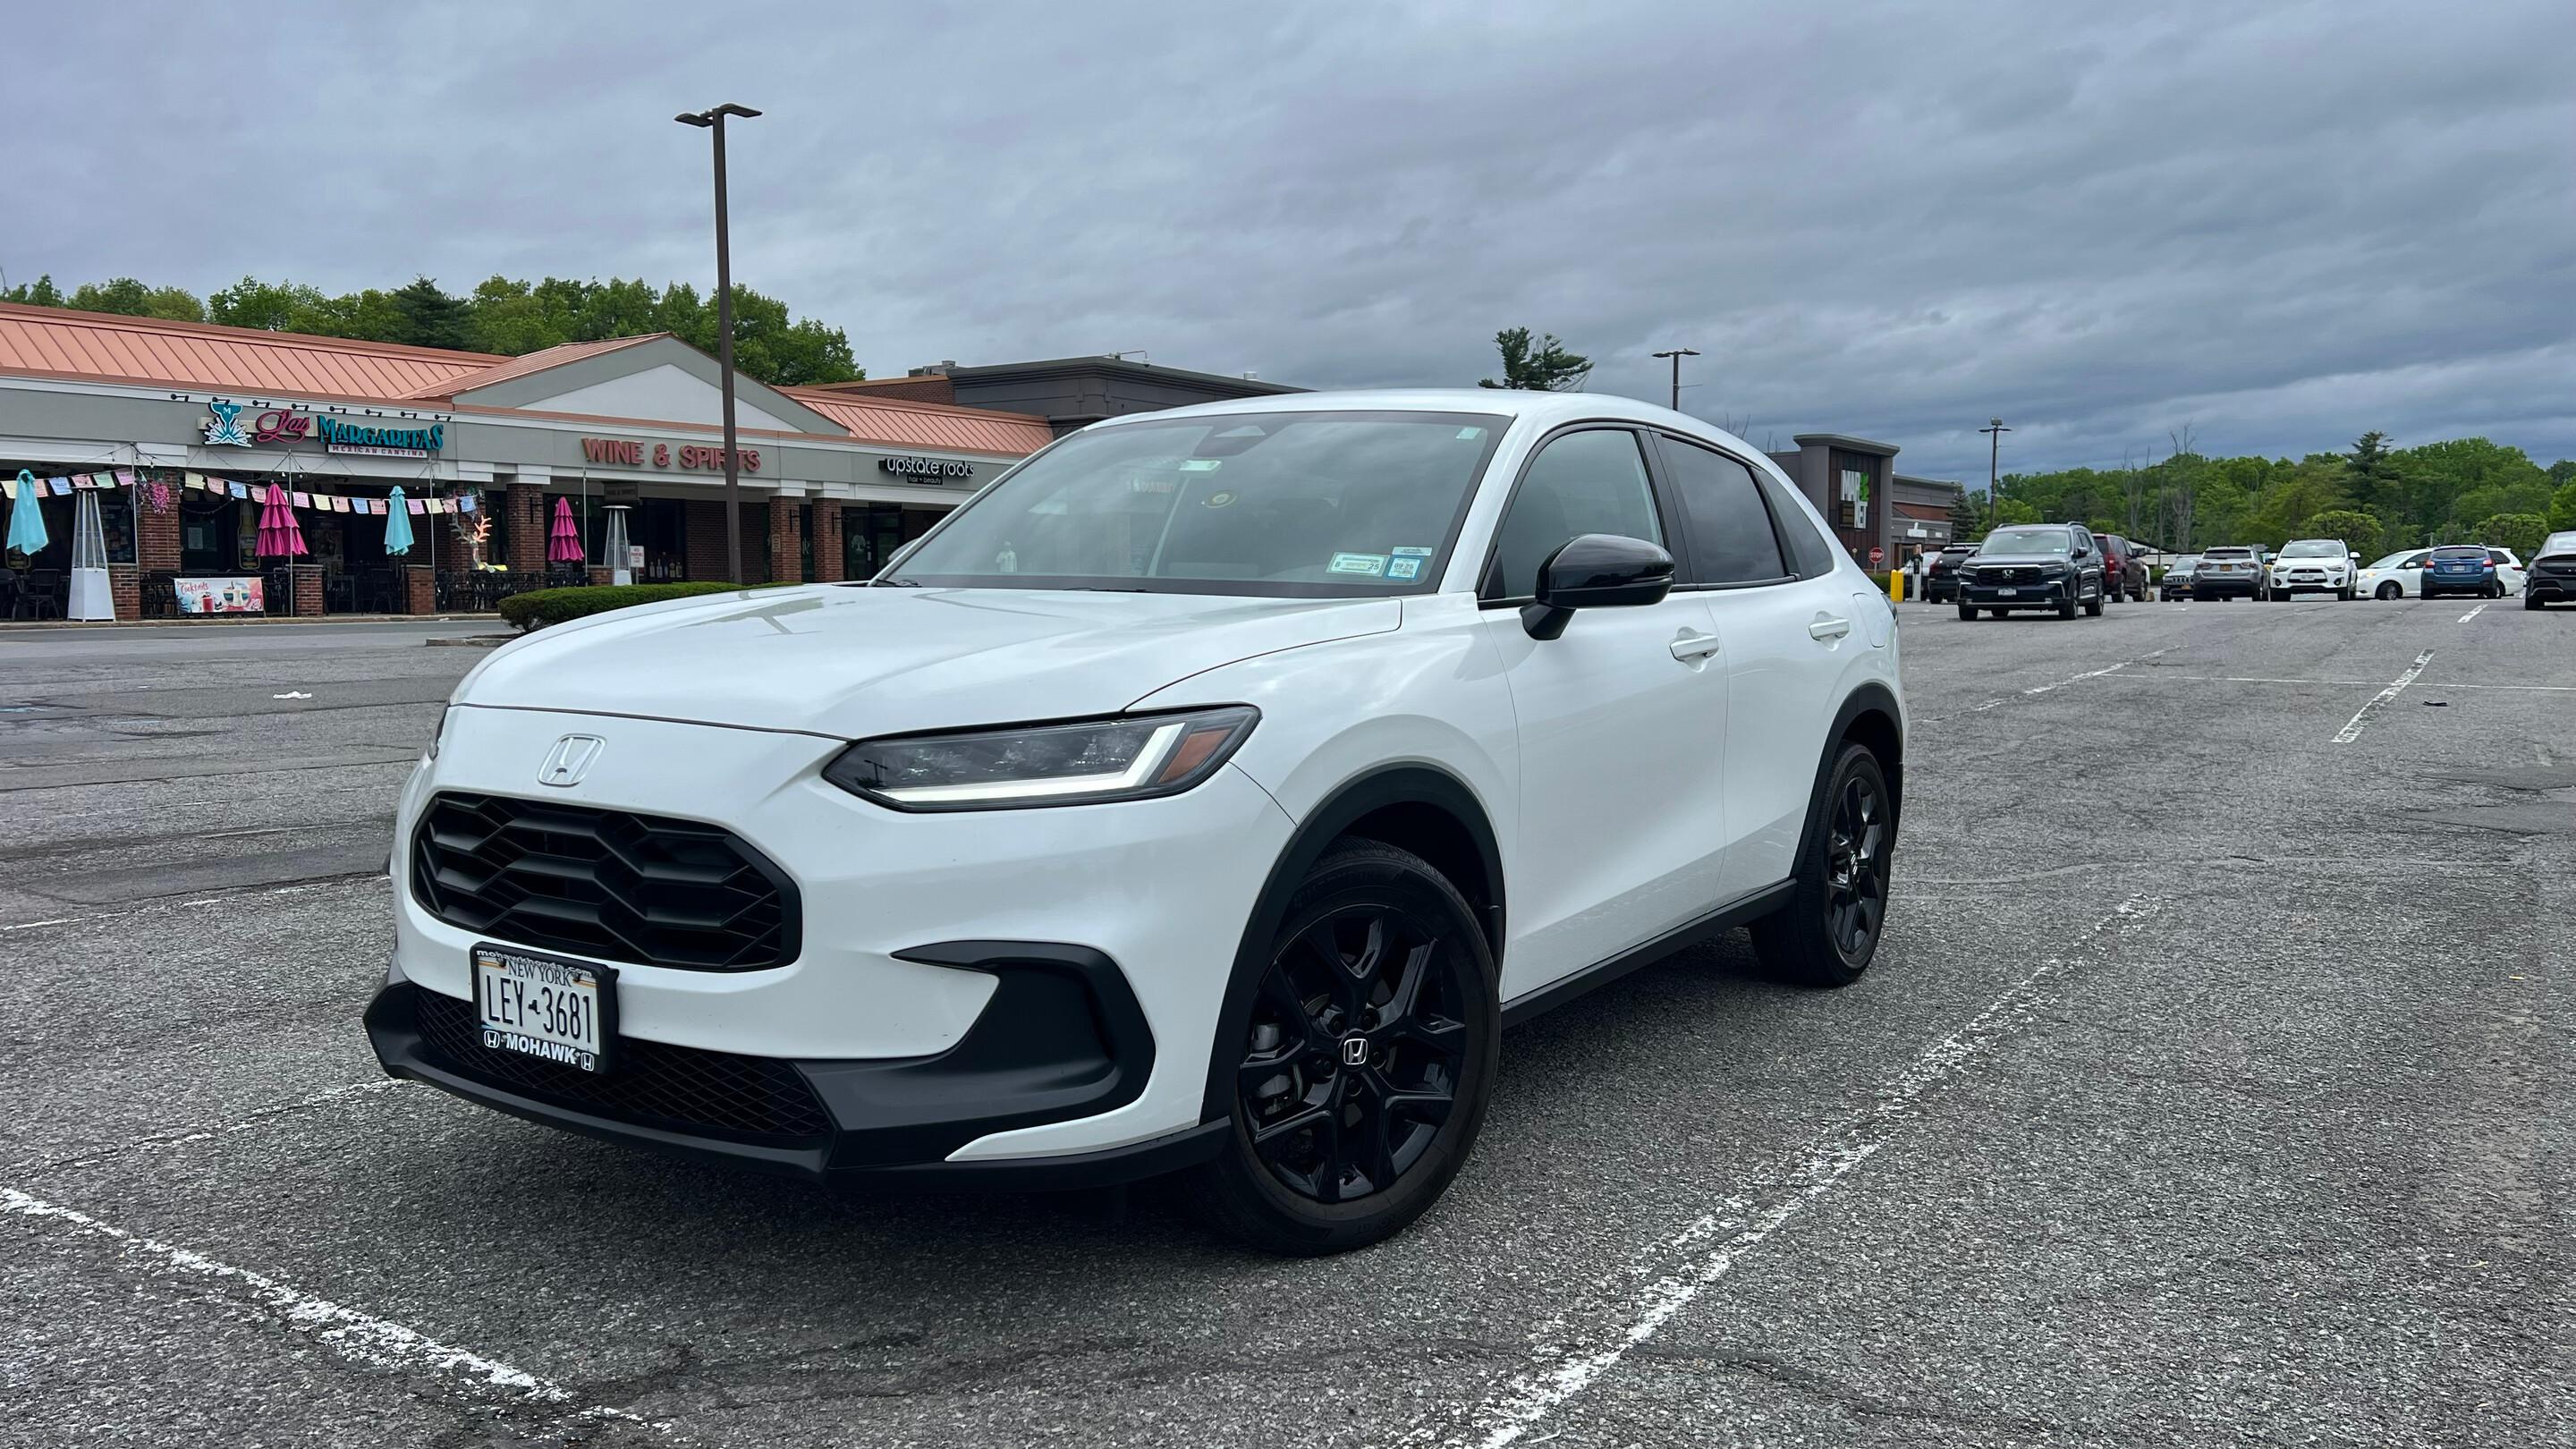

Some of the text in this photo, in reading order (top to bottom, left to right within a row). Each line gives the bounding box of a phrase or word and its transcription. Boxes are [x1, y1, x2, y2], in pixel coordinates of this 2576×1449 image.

[257, 409, 444, 451] Las MARGARITAS
[332, 445, 424, 457] MEXICAN CANTINA
[582, 437, 761, 473] WINE & SPIRTS
[886, 456, 975, 478] upstate roots
[1870, 551, 1883, 559] STOP
[476, 949, 592, 978] mohawkhonda.com
[507, 961, 572, 987] NEW YORK
[505, 1032, 576, 1065] MOHAWK
